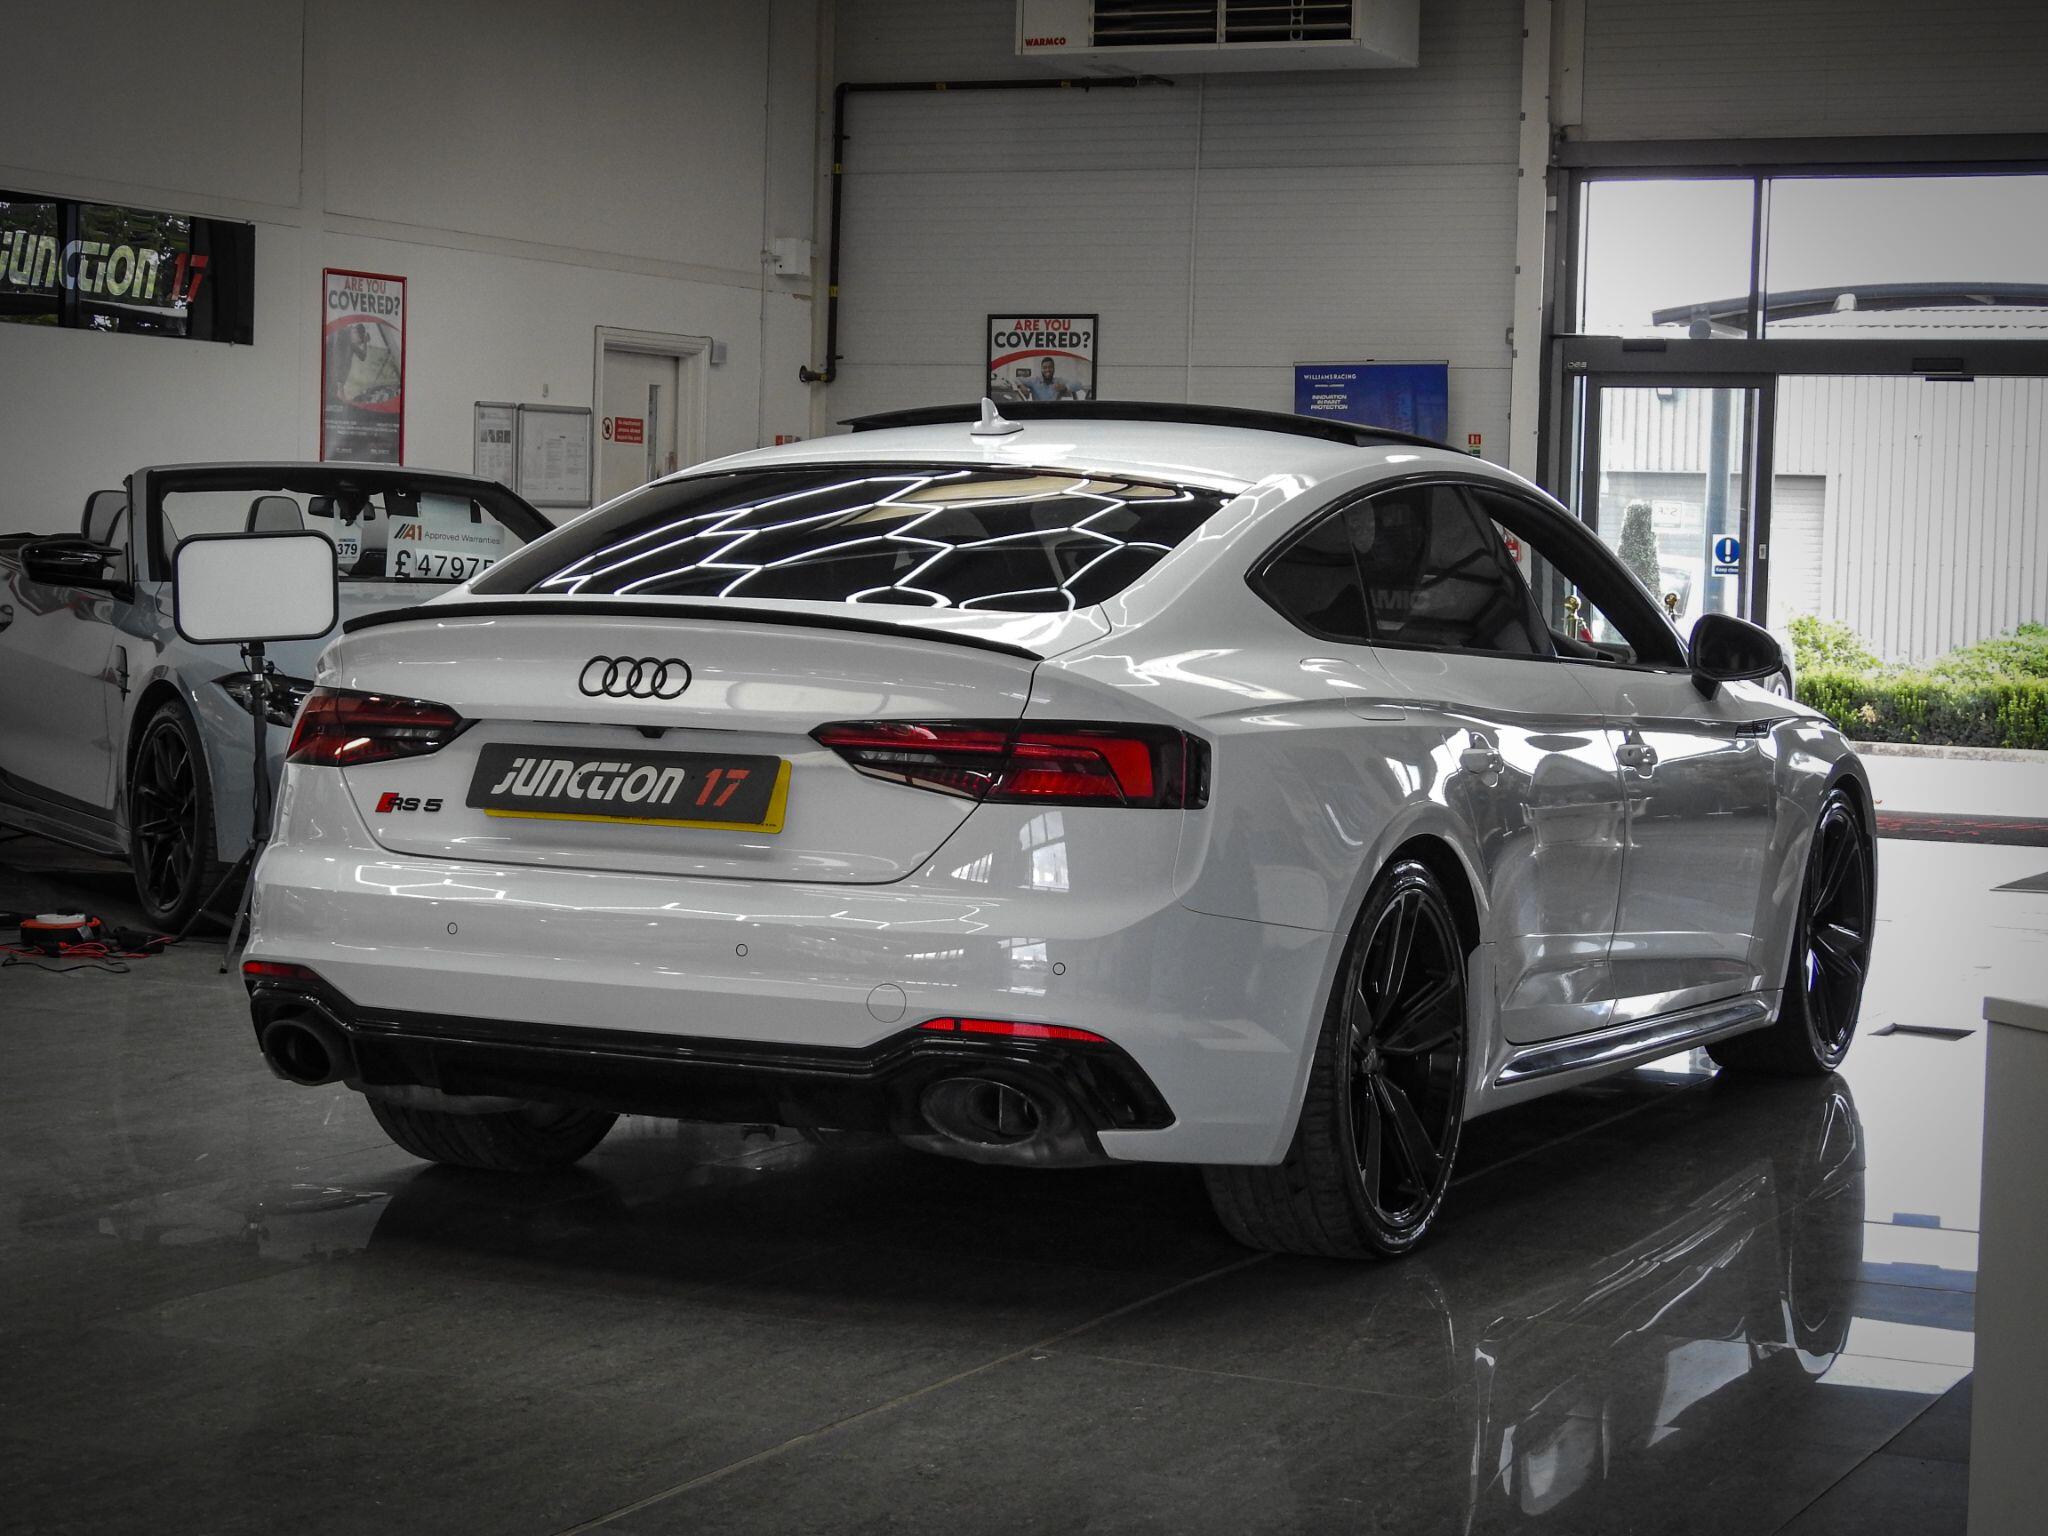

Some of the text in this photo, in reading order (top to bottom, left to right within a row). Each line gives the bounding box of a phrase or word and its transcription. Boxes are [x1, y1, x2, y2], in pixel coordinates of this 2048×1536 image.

[1025, 37, 1066, 46] WARMCO
[170, 252, 209, 302] 17
[344, 277, 387, 294] ARE YOU
[328, 290, 401, 316] COVERED?
[1014, 319, 1072, 331] ARE YOU
[993, 331, 1092, 349] COVERED?
[424, 530, 460, 542] Approved
[461, 532, 500, 545] Warranties
[337, 543, 358, 556] 379
[696, 768, 750, 807] 17
